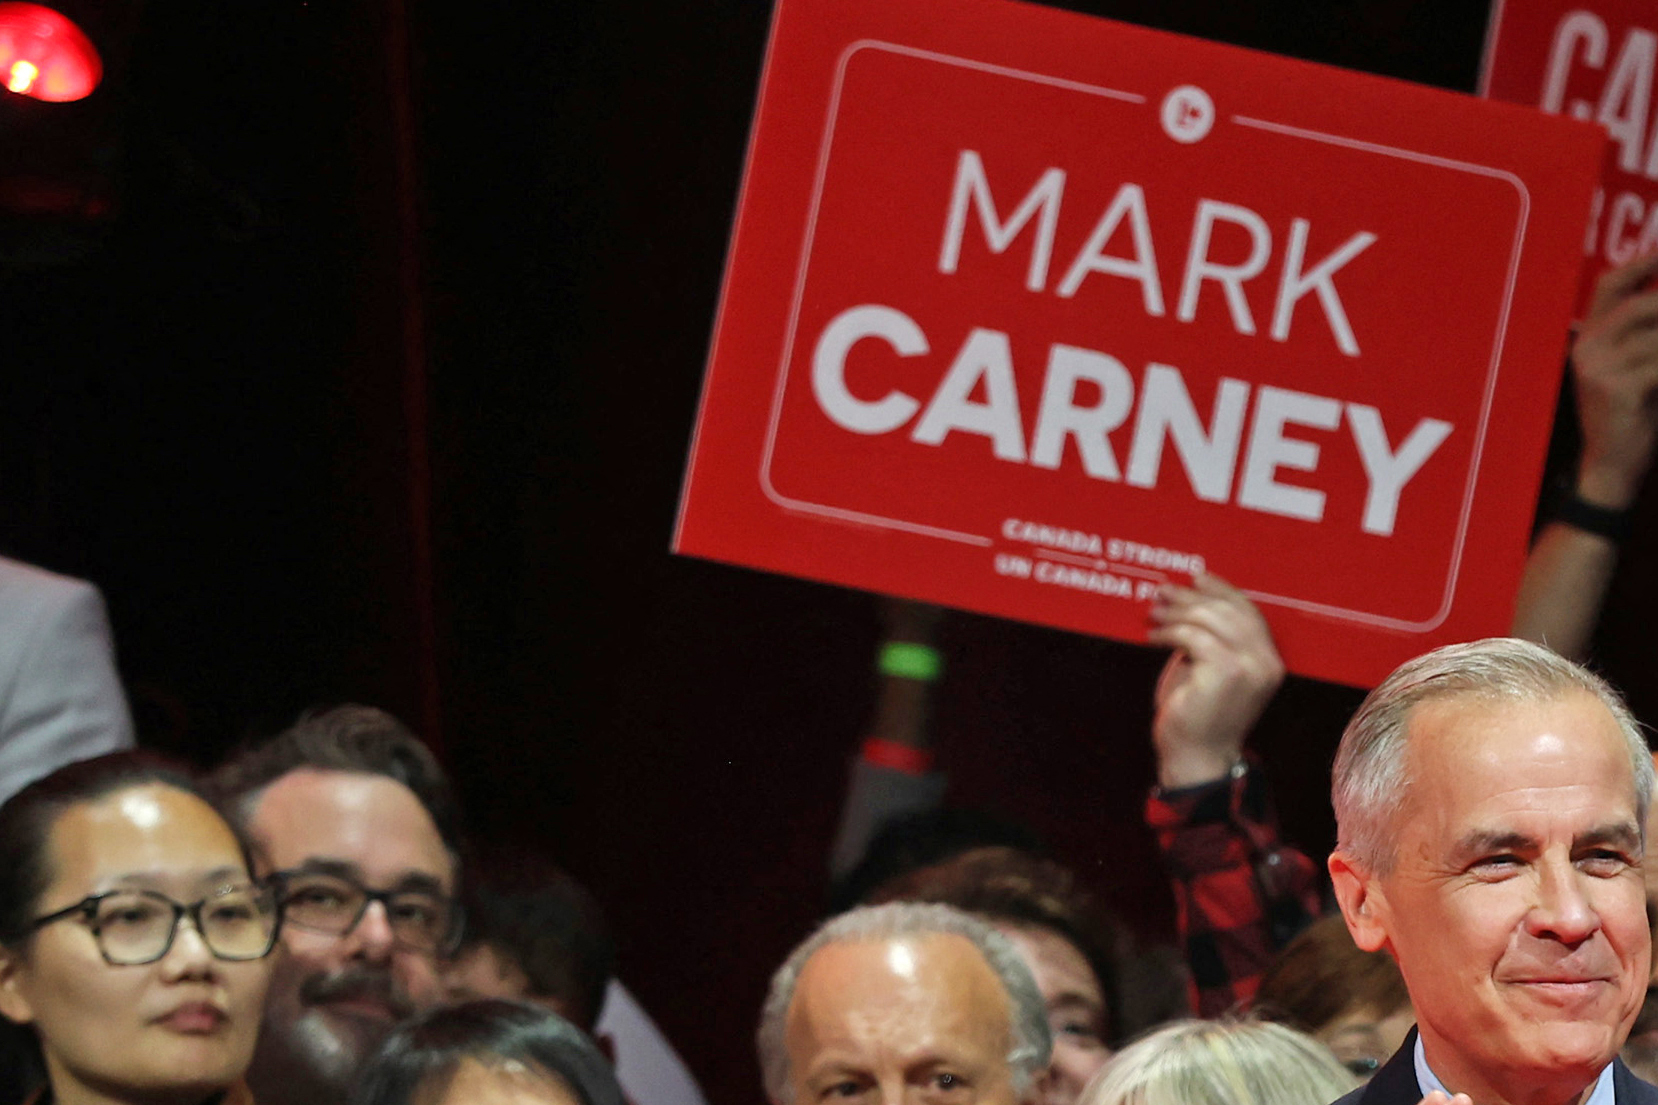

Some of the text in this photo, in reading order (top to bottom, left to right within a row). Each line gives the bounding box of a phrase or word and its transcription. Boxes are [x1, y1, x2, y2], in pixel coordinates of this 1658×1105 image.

[938, 149, 1377, 356] MARK
[811, 304, 1454, 536] CARNEY
[994, 552, 1034, 580] UN
[1034, 560, 1133, 598] CANADA
[1002, 517, 1206, 575] CANADA STRONG
